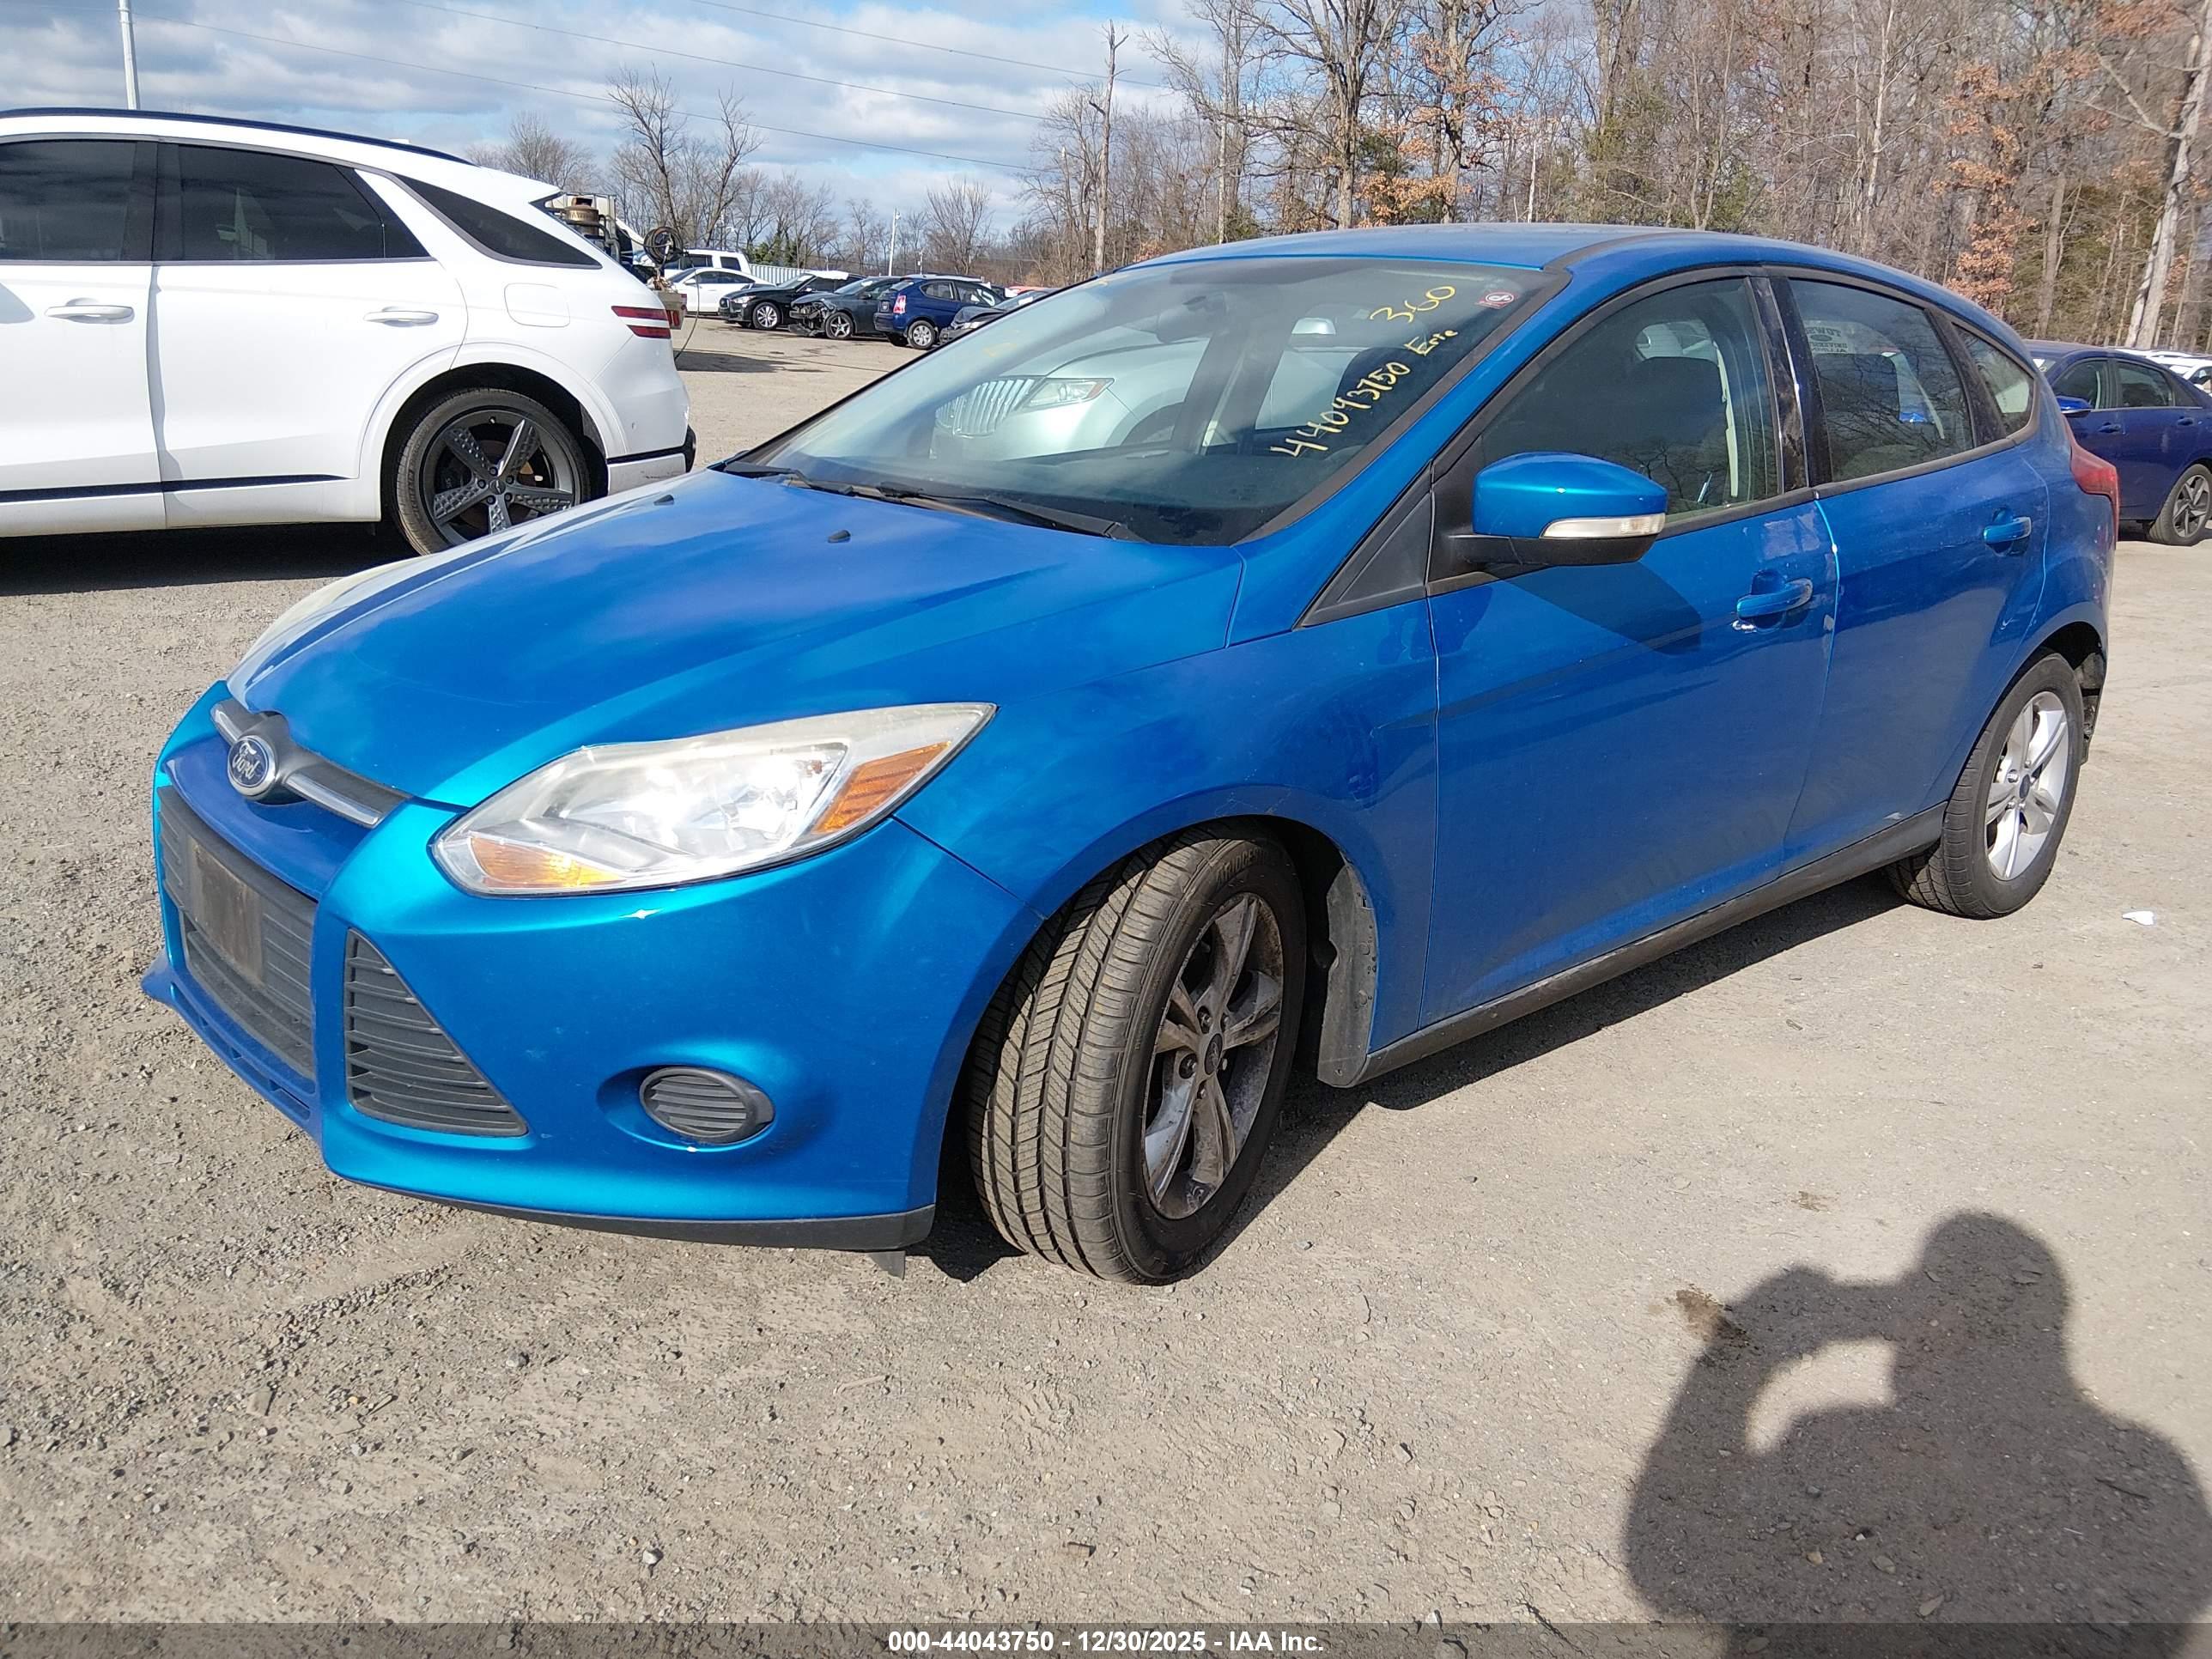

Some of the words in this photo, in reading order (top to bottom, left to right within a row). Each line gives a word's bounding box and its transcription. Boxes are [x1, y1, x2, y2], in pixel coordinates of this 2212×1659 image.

[1369, 285, 1455, 324] 360
[1269, 361, 1411, 458] 44043750
[232, 741, 261, 781] Ford
